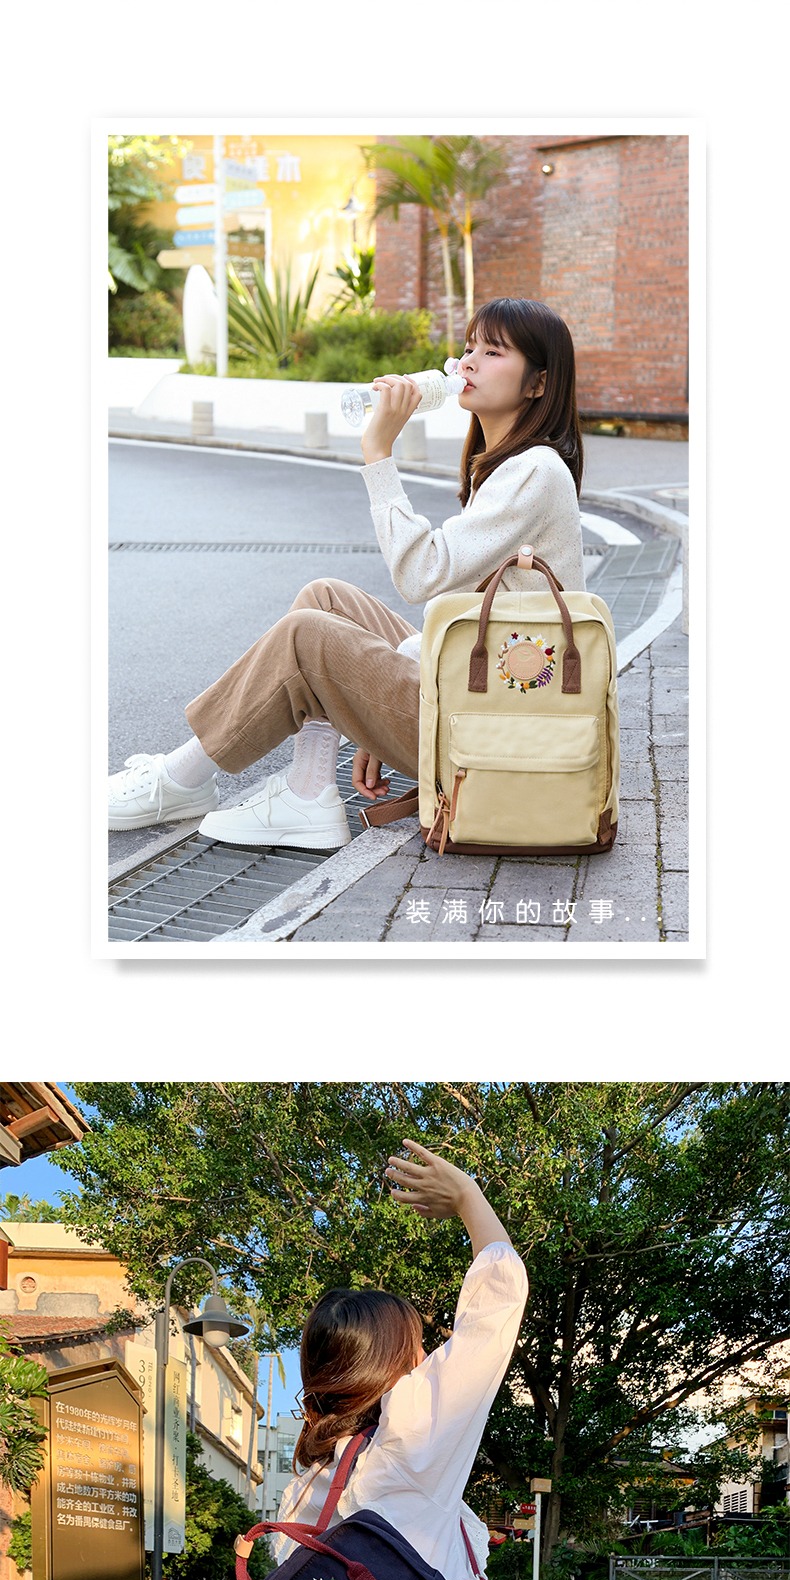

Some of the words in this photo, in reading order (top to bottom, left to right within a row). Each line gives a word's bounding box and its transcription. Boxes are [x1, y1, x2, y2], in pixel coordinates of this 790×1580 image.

[56, 1482, 137, 1503] 成占地数万平方米的功
